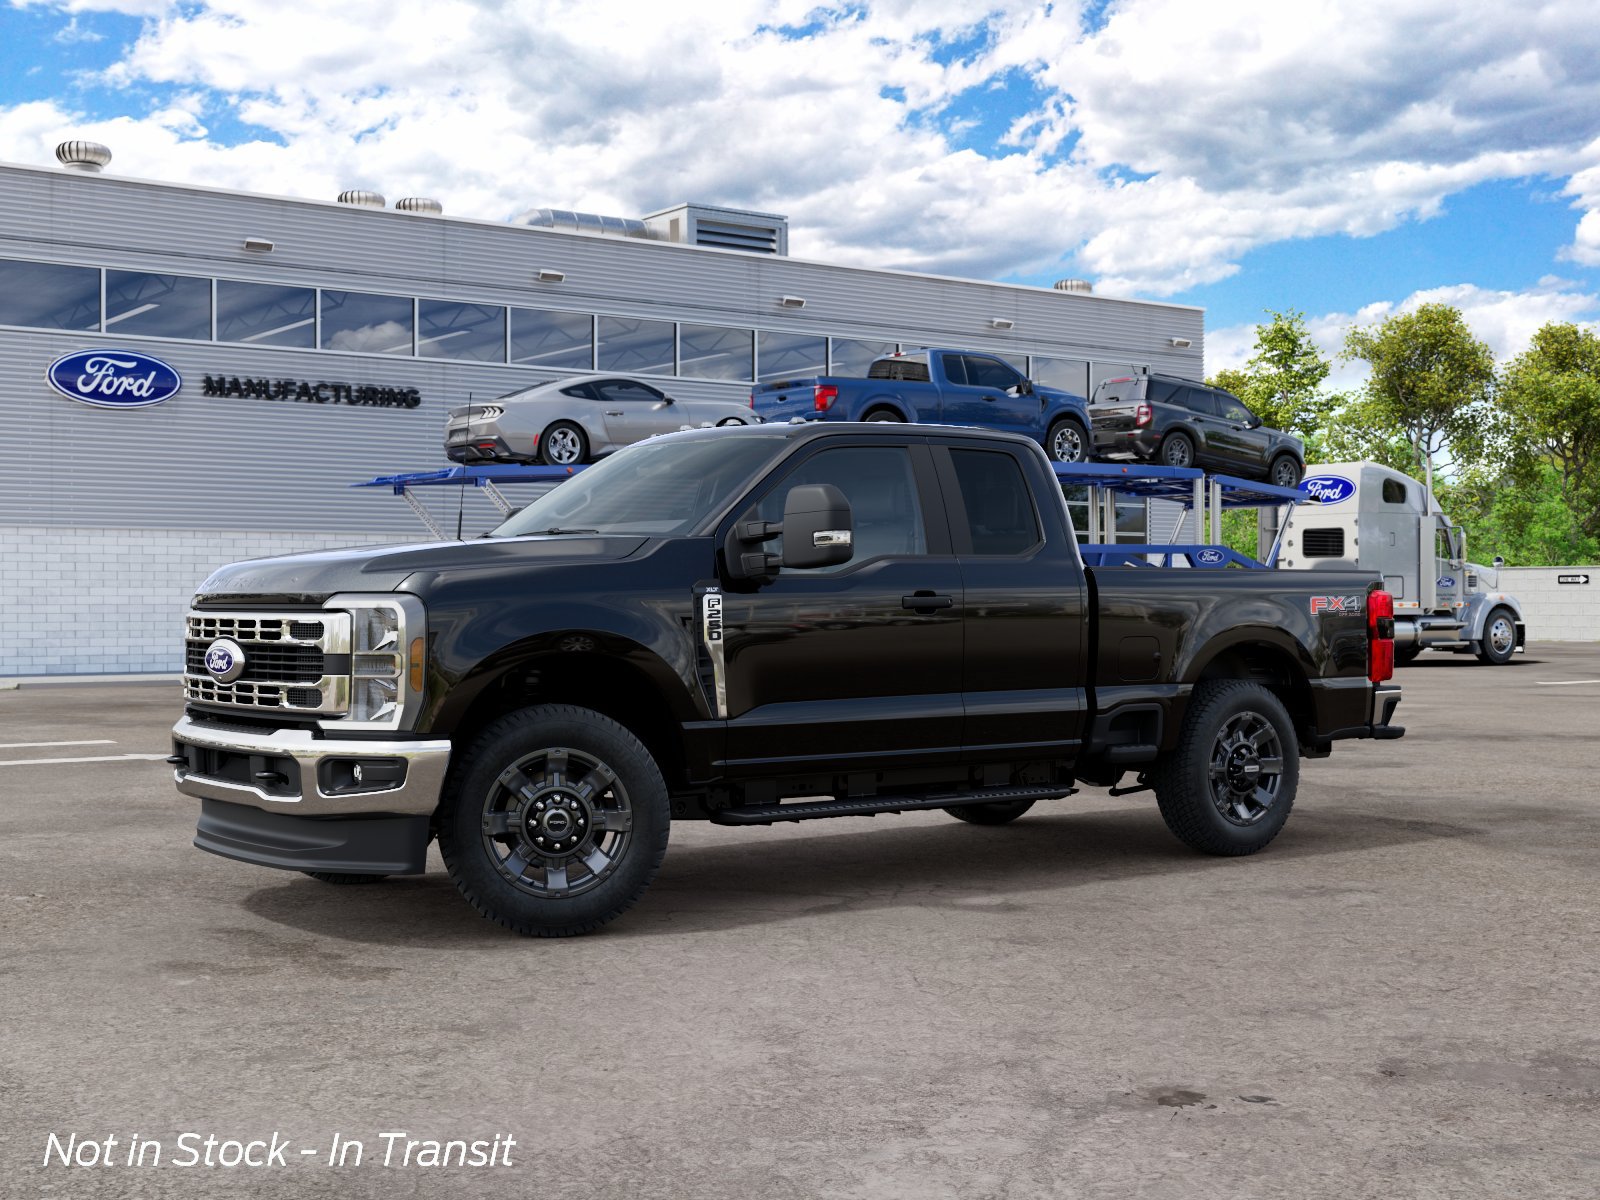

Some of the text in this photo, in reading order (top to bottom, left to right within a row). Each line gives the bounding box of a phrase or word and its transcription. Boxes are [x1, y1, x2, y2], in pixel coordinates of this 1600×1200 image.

[77, 357, 157, 397] Ford
[203, 373, 421, 408] MANUFACTURING
[1305, 480, 1343, 500] Ford
[1201, 551, 1220, 562] Ford
[1310, 596, 1361, 616] FX4
[210, 650, 229, 670] Ford
